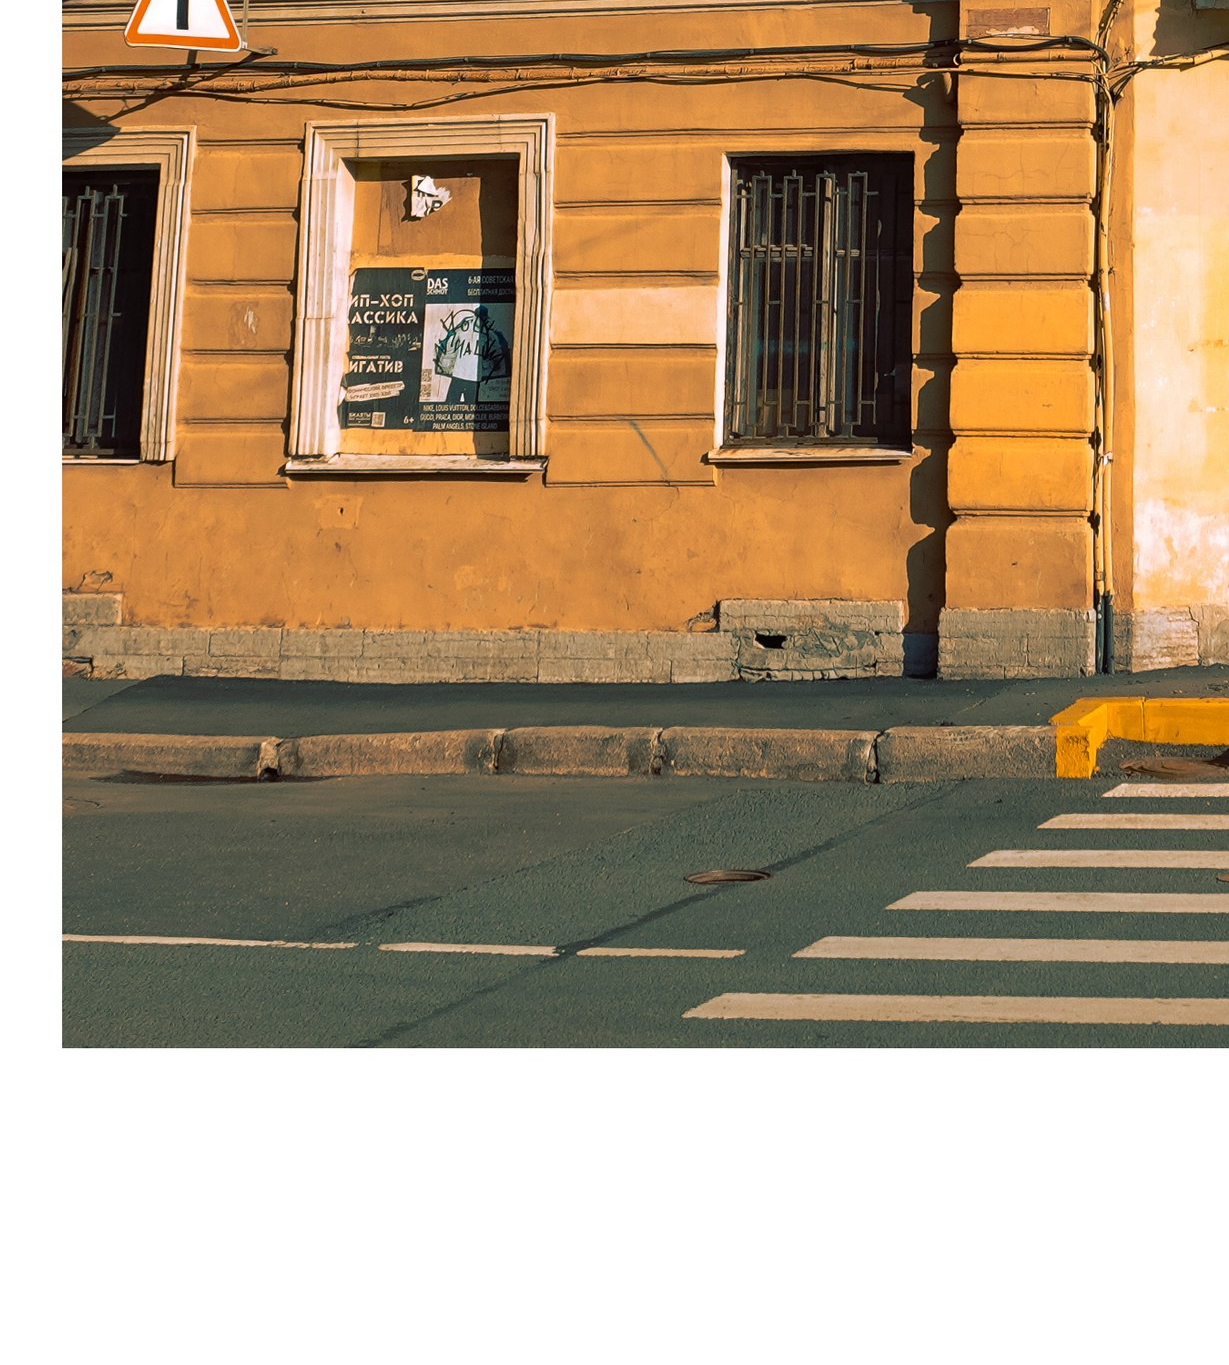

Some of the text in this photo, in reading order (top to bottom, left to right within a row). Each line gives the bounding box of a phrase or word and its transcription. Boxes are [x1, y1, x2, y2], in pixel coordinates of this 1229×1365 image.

[427, 277, 448, 289] DAS
[351, 293, 414, 307] ИП-ХОП
[349, 310, 419, 324] АССИКА
[349, 360, 404, 373] ИГАТИВ
[403, 415, 415, 424] 6+
